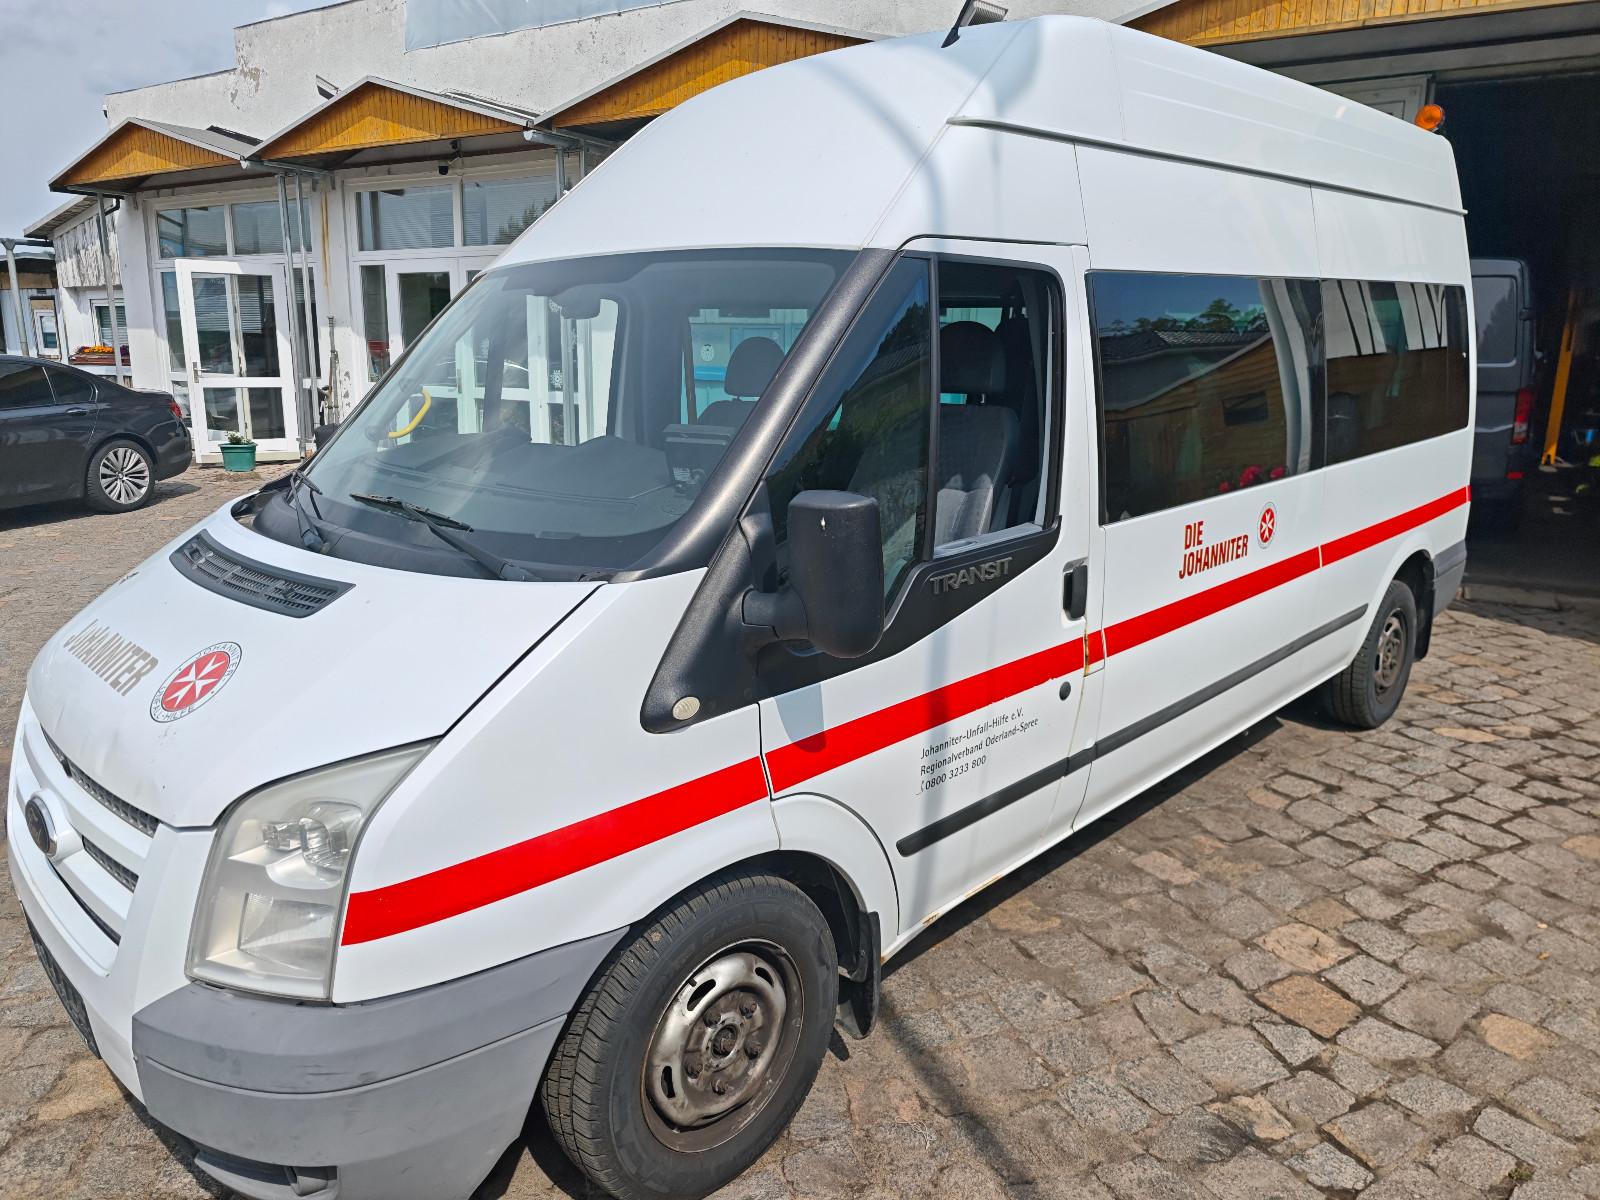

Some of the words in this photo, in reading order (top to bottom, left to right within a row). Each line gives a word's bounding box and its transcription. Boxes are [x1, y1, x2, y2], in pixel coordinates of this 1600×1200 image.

[1179, 534, 1249, 579] JOHANNITER
[1184, 520, 1204, 550] DIE
[929, 556, 1013, 595] TRANSIT
[63, 618, 159, 697] JOHANNITER
[920, 715, 1009, 760] Johanniter-Unfall-Hilfe
[1011, 707, 1024, 721] e.V.
[920, 739, 983, 777] Regionalverband
[985, 718, 1039, 748] Oderland-Spree
[925, 773, 947, 791] 0800
[949, 763, 969, 780] 3233
[971, 755, 987, 769] 800
